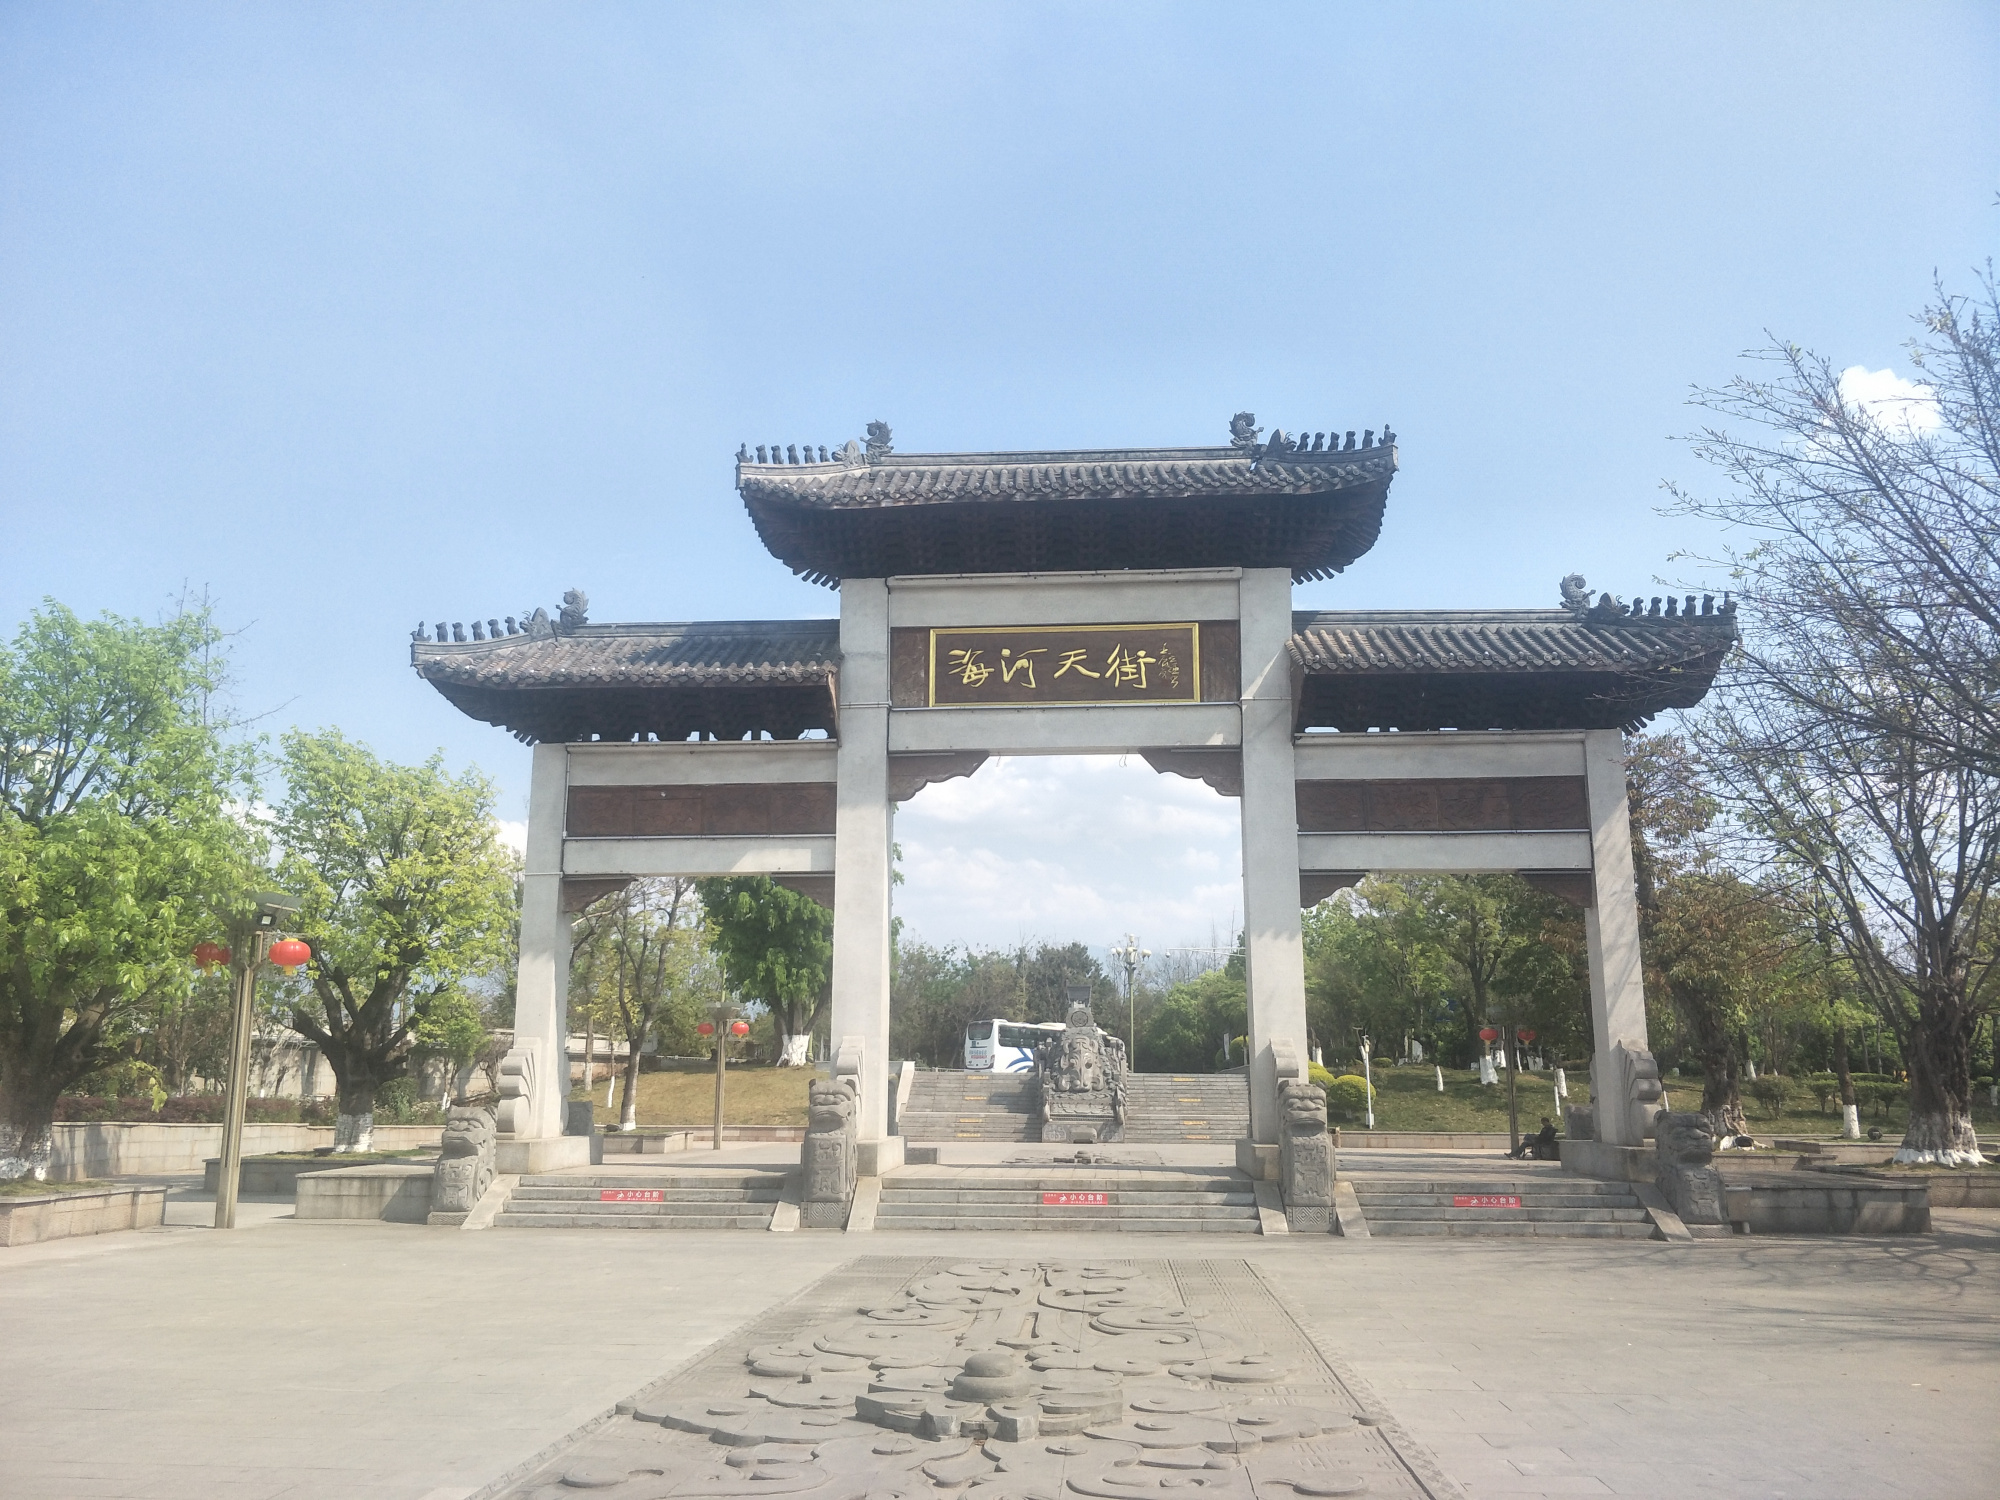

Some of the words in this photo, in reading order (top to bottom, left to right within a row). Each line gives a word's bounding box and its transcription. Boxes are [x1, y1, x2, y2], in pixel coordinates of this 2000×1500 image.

[627, 1190, 659, 1198] 小心台阶
[1070, 1193, 1103, 1201] 小心台阶
[1482, 1196, 1516, 1204] 小心台阶
